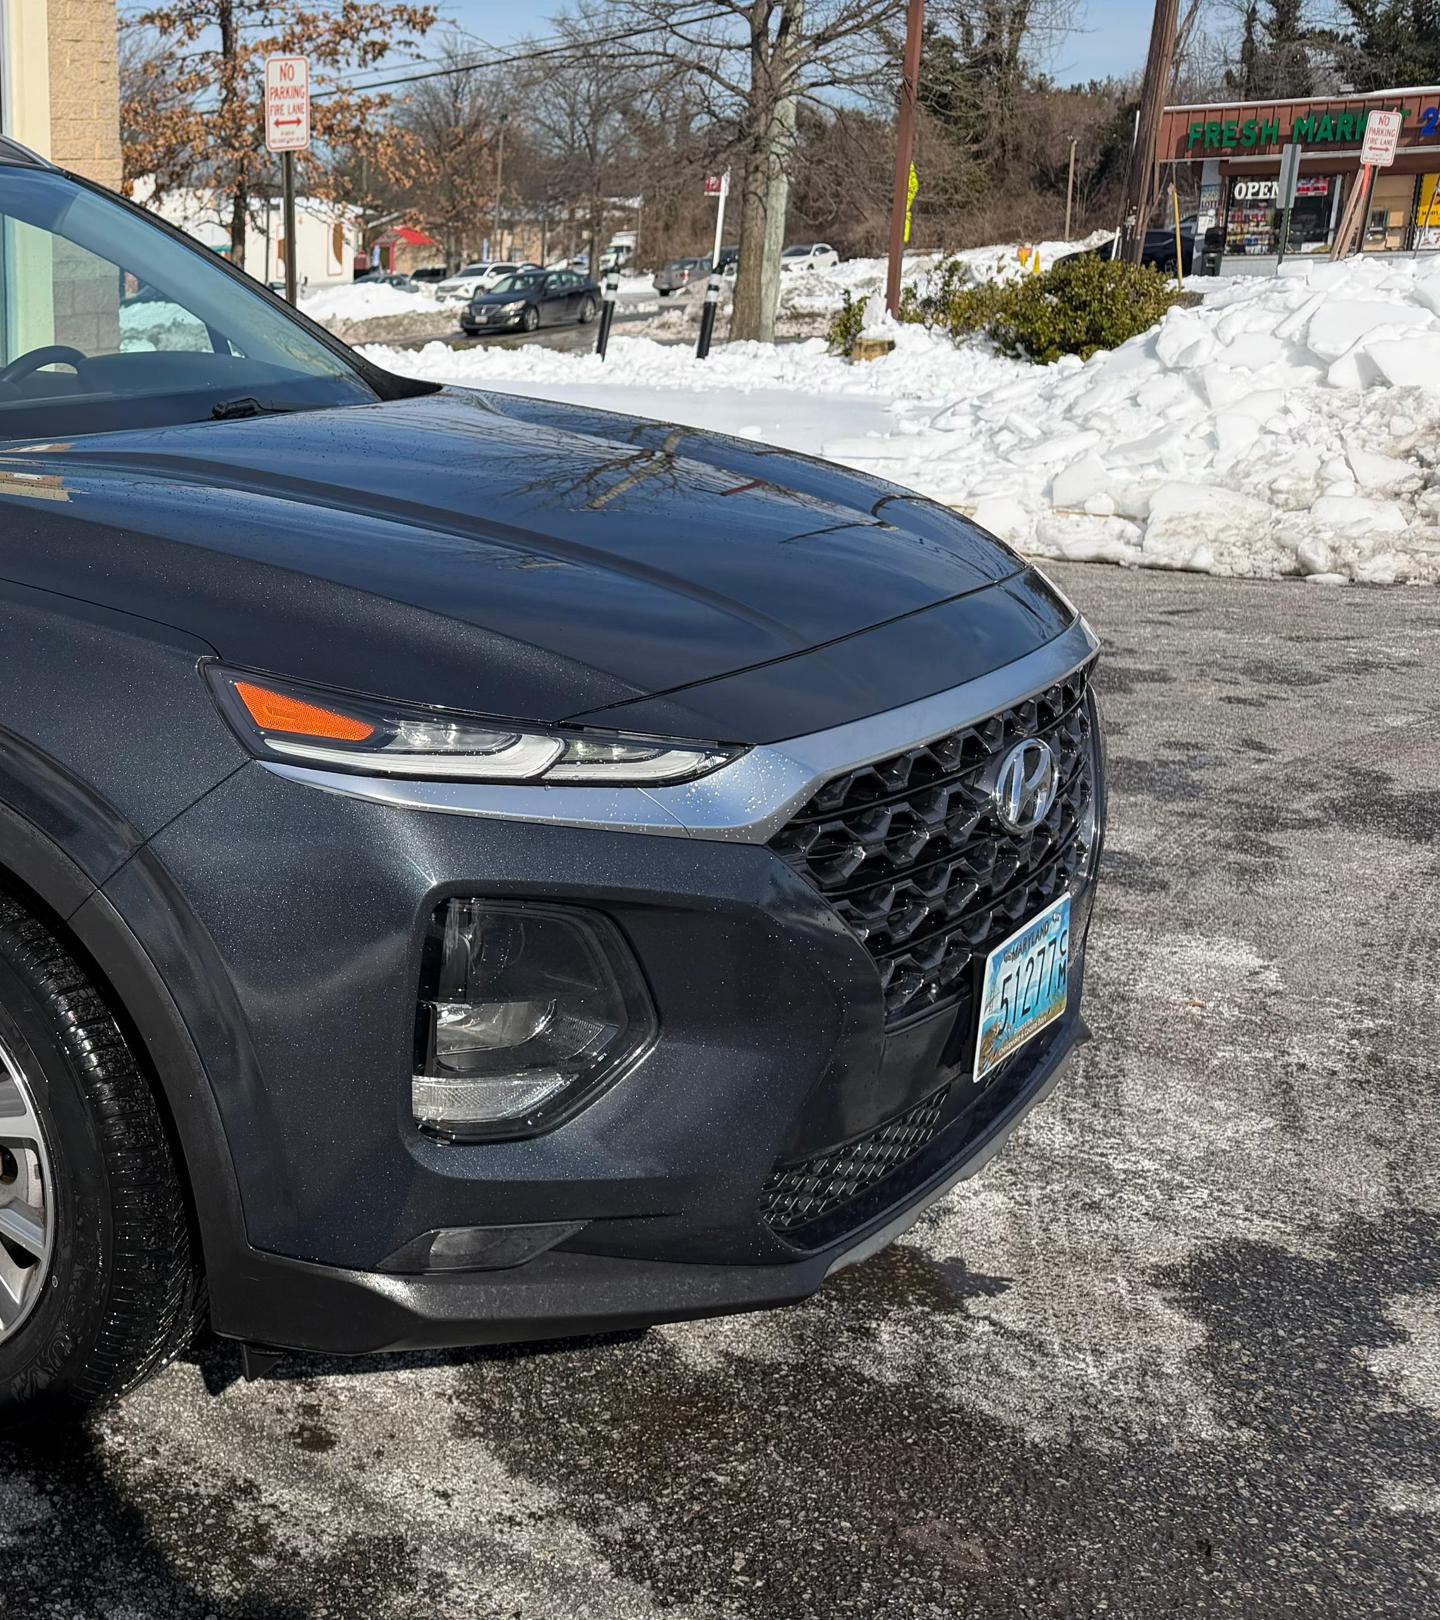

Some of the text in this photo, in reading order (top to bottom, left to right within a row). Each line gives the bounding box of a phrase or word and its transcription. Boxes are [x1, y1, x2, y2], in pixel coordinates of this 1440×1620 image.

[279, 63, 295, 82] NO
[270, 86, 305, 100] PARKING
[270, 103, 305, 116] FIRE LANE
[1378, 115, 1390, 127] NO
[1187, 118, 1280, 149] FRESH
[1369, 127, 1396, 138] PARKING
[998, 936, 1058, 1036] 51277
